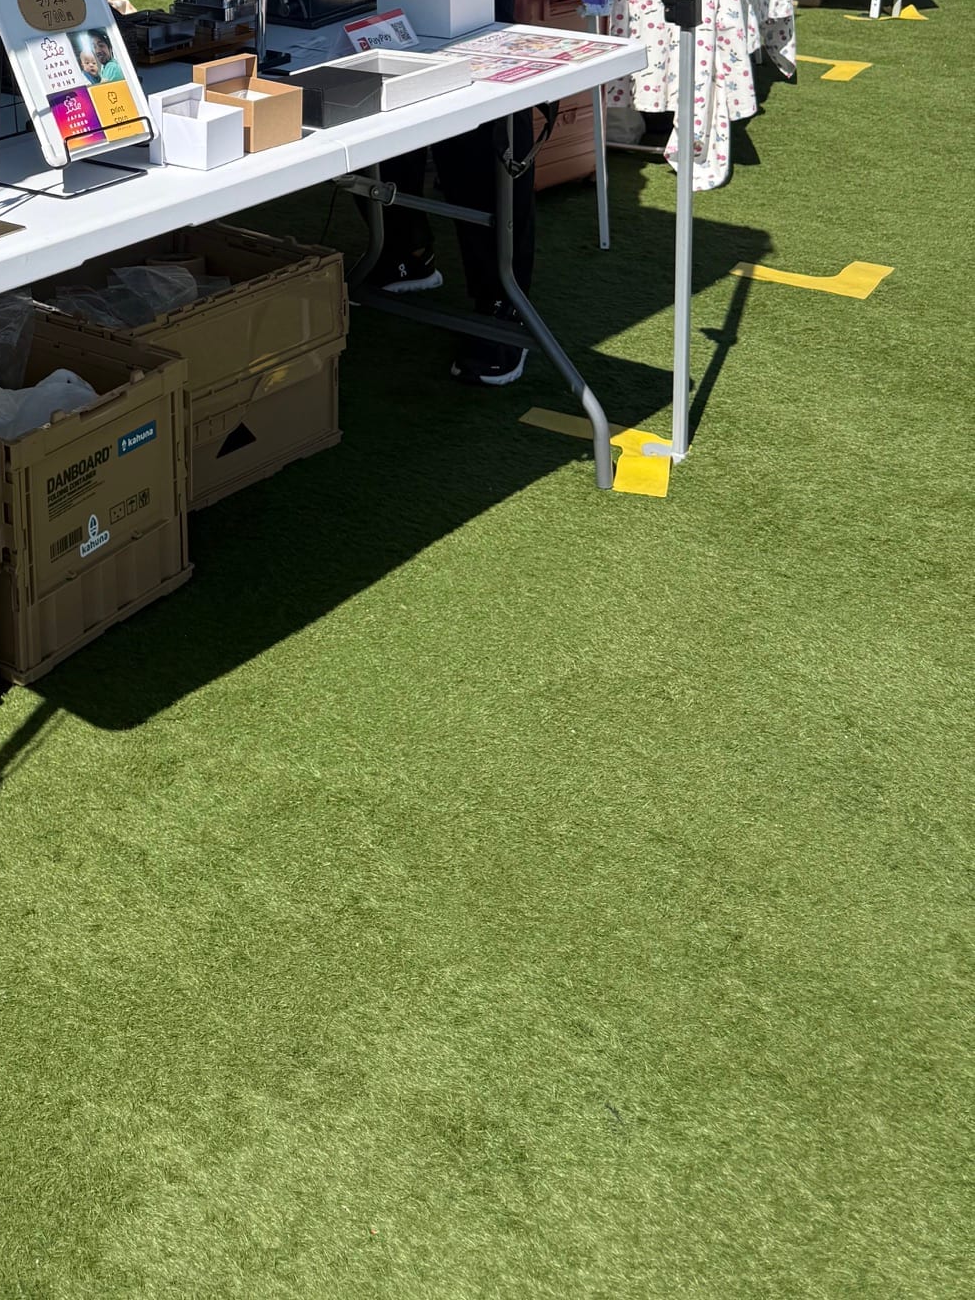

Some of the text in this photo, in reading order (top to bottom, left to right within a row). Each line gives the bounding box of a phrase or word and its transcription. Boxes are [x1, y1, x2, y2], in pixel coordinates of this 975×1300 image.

[367, 33, 392, 45] PayPay
[45, 60, 70, 70] JAPAN
[48, 68, 73, 79] KANKO
[52, 78, 76, 89] PRINT
[110, 105, 125, 115] print
[67, 112, 86, 122] JAPAN
[128, 428, 153, 447] kahuna
[47, 446, 110, 495] DANBOARD
[81, 532, 108, 554] kahuna
